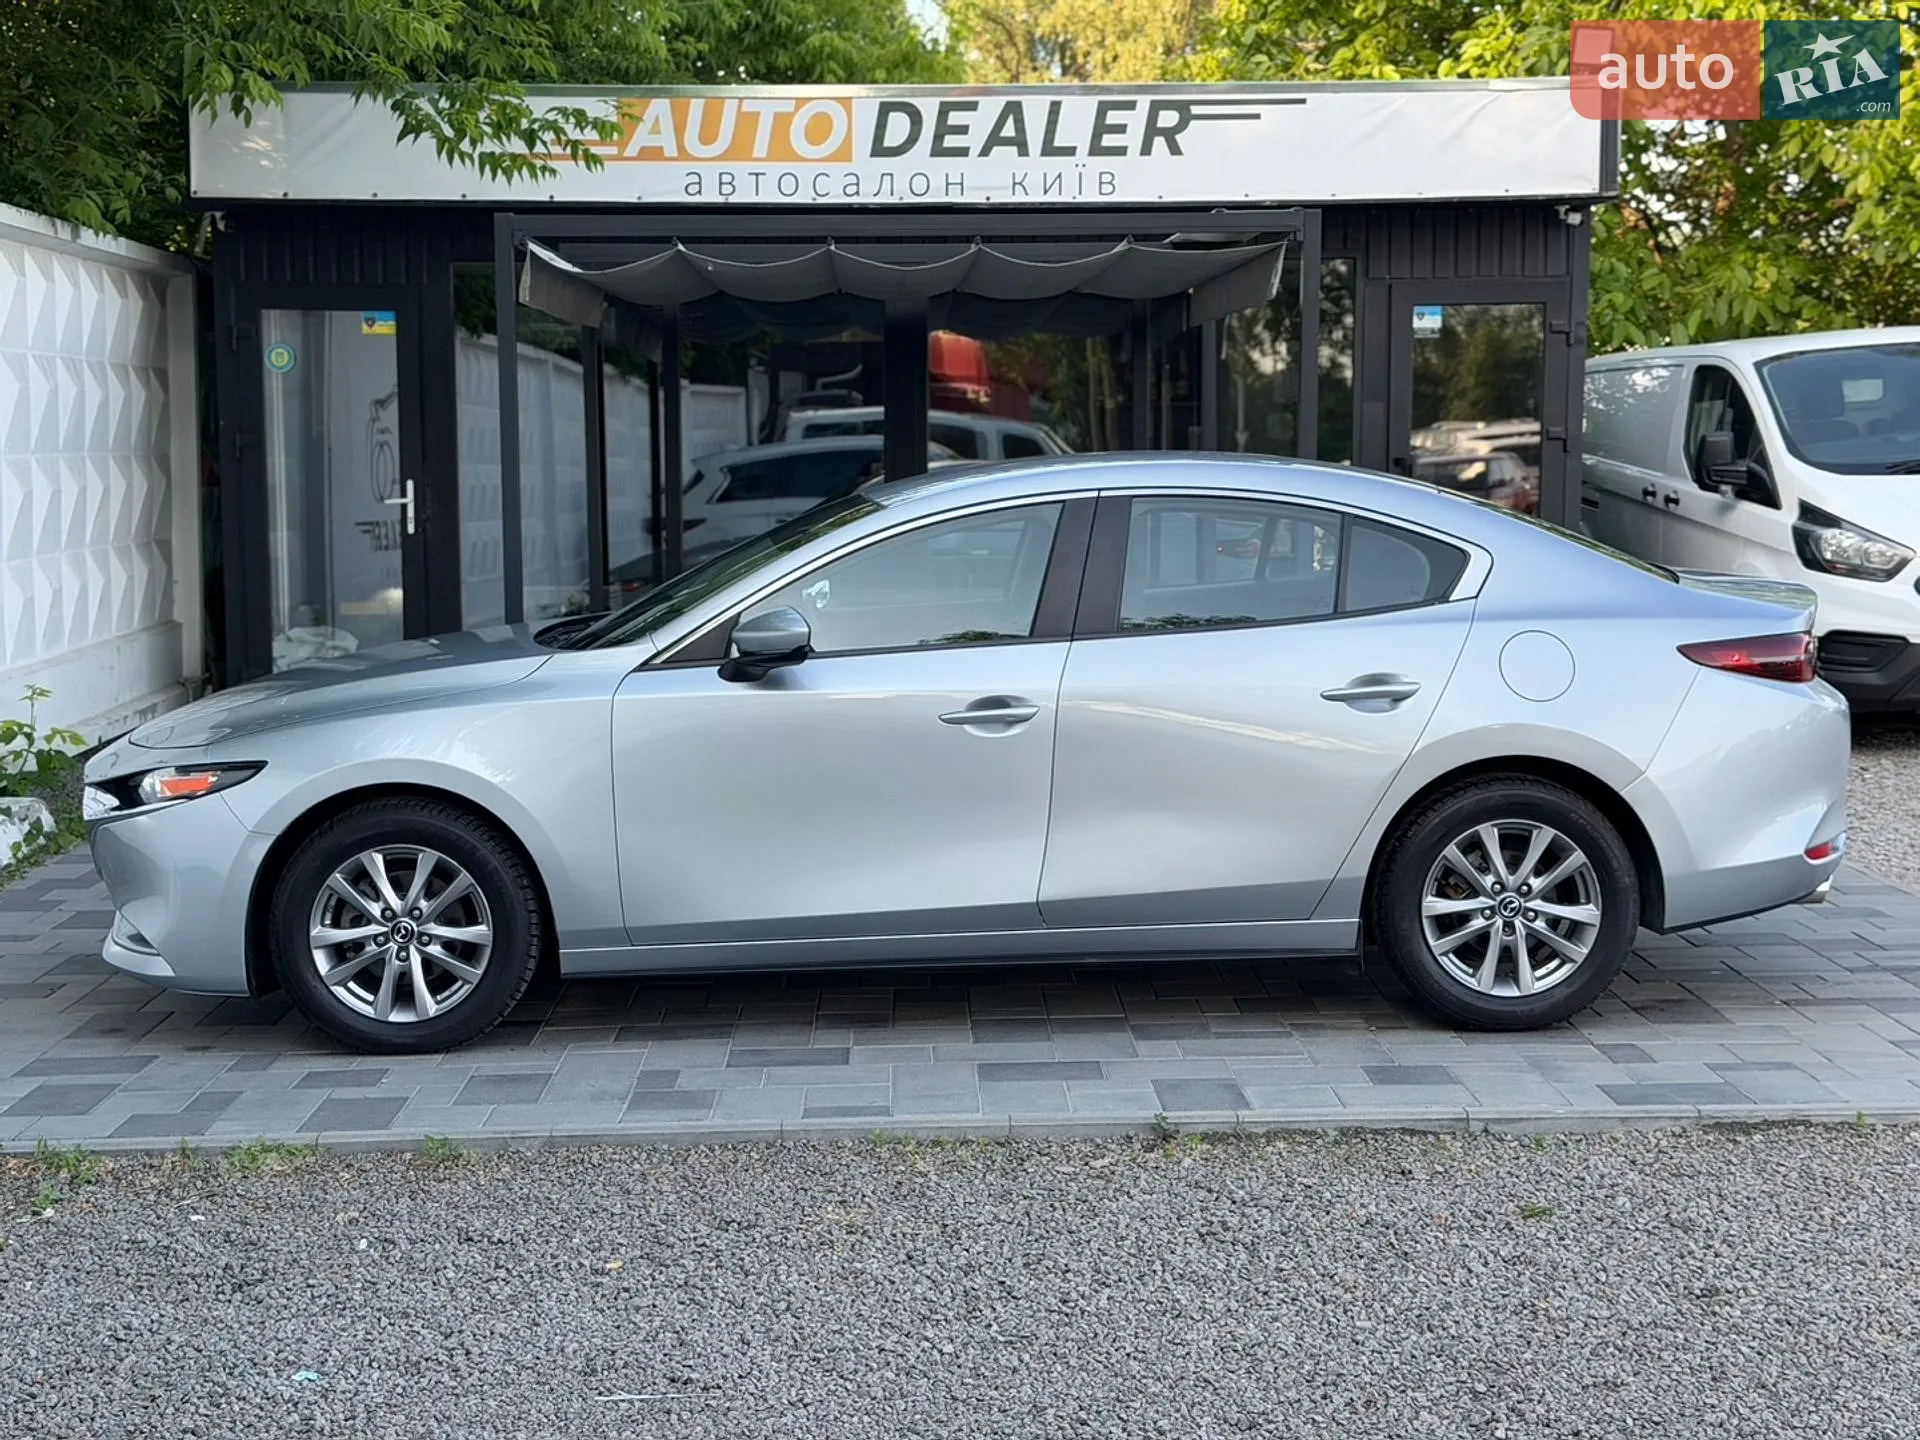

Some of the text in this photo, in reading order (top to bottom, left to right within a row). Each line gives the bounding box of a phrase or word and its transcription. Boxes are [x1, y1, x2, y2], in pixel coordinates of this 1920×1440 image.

[623, 98, 1192, 160] AUTO DEALER
[683, 171, 966, 198] автосалон
